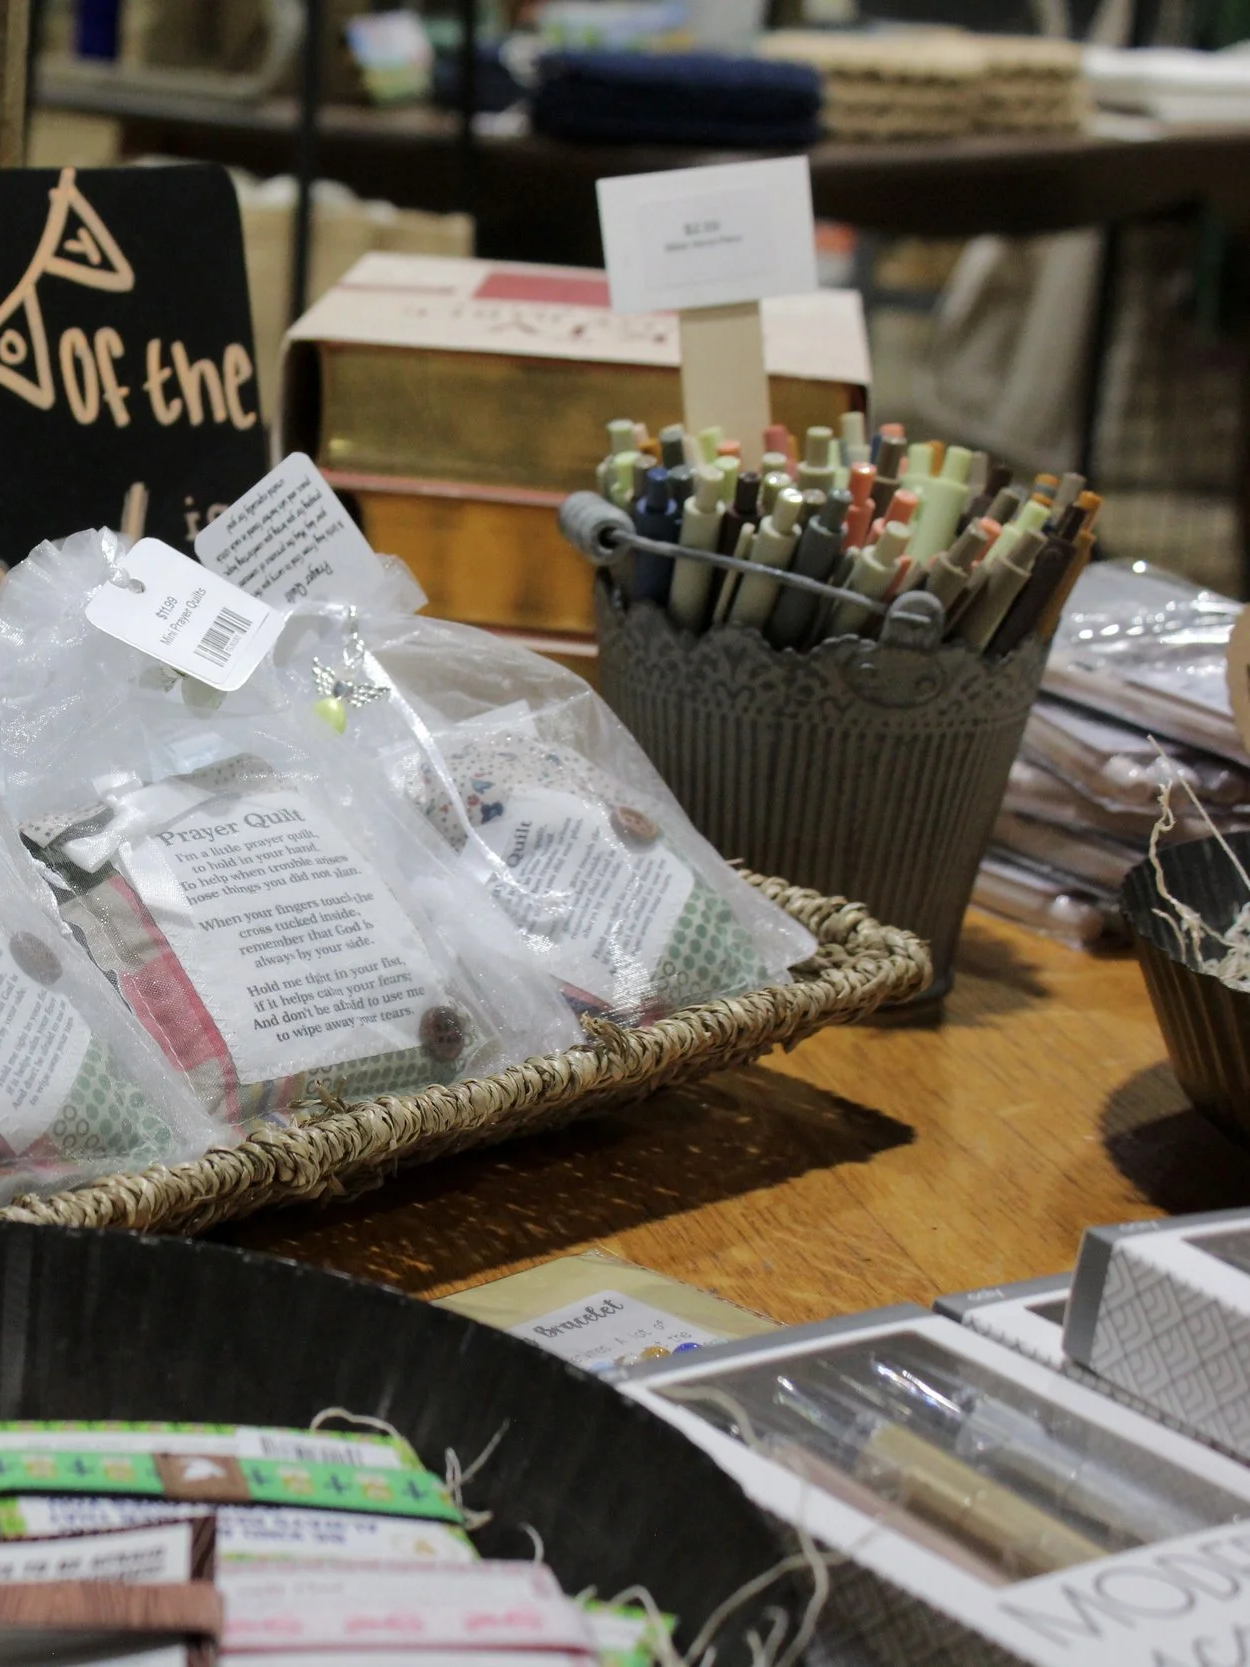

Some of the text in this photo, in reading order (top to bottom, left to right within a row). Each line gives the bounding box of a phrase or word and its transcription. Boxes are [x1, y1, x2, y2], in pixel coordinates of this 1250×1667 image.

[143, 338, 257, 430] the
[154, 594, 178, 621] $11.99
[159, 585, 207, 647] Mini Prayer Quilts
[156, 808, 306, 847] Prayer Quilt
[502, 818, 536, 869] Quilt
[175, 851, 198, 863] I'm
[200, 850, 210, 859] a
[210, 844, 241, 857] little
[244, 834, 284, 852] prayer
[192, 865, 207, 874] to
[206, 858, 237, 871] hold
[238, 855, 253, 866] in
[255, 849, 284, 864] your
[186, 891, 220, 906] hose
[221, 882, 262, 896] things
[263, 877, 287, 892] you
[288, 870, 310, 884] did
[310, 868, 331, 880] not
[198, 874, 229, 888] help
[230, 866, 266, 881] when
[268, 856, 312, 874] trouble
[199, 913, 243, 933] When
[244, 907, 273, 925] your
[275, 898, 319, 916] fingers
[238, 924, 273, 939] cross
[275, 912, 319, 932] tucked
[238, 934, 305, 956] remember
[307, 926, 333, 942] that
[334, 921, 362, 936] God
[254, 953, 295, 970] always
[296, 948, 312, 962] by
[314, 942, 343, 960] your
[246, 979, 280, 998] Hold
[282, 977, 304, 990] me
[334, 968, 349, 982] in
[350, 961, 379, 980] your
[253, 1000, 266, 1014] if
[266, 998, 279, 1011] it
[280, 990, 315, 1009] helps
[346, 978, 376, 995] your
[253, 1013, 280, 1031] And
[281, 1006, 313, 1025] don't
[314, 1003, 331, 1017] be
[368, 995, 380, 1007] to
[382, 990, 405, 1005] use
[406, 985, 426, 999] me
[276, 1030, 291, 1043] to
[292, 1022, 323, 1040] wipe
[325, 1015, 356, 1033] away
[532, 1298, 624, 1339] Bracelet
